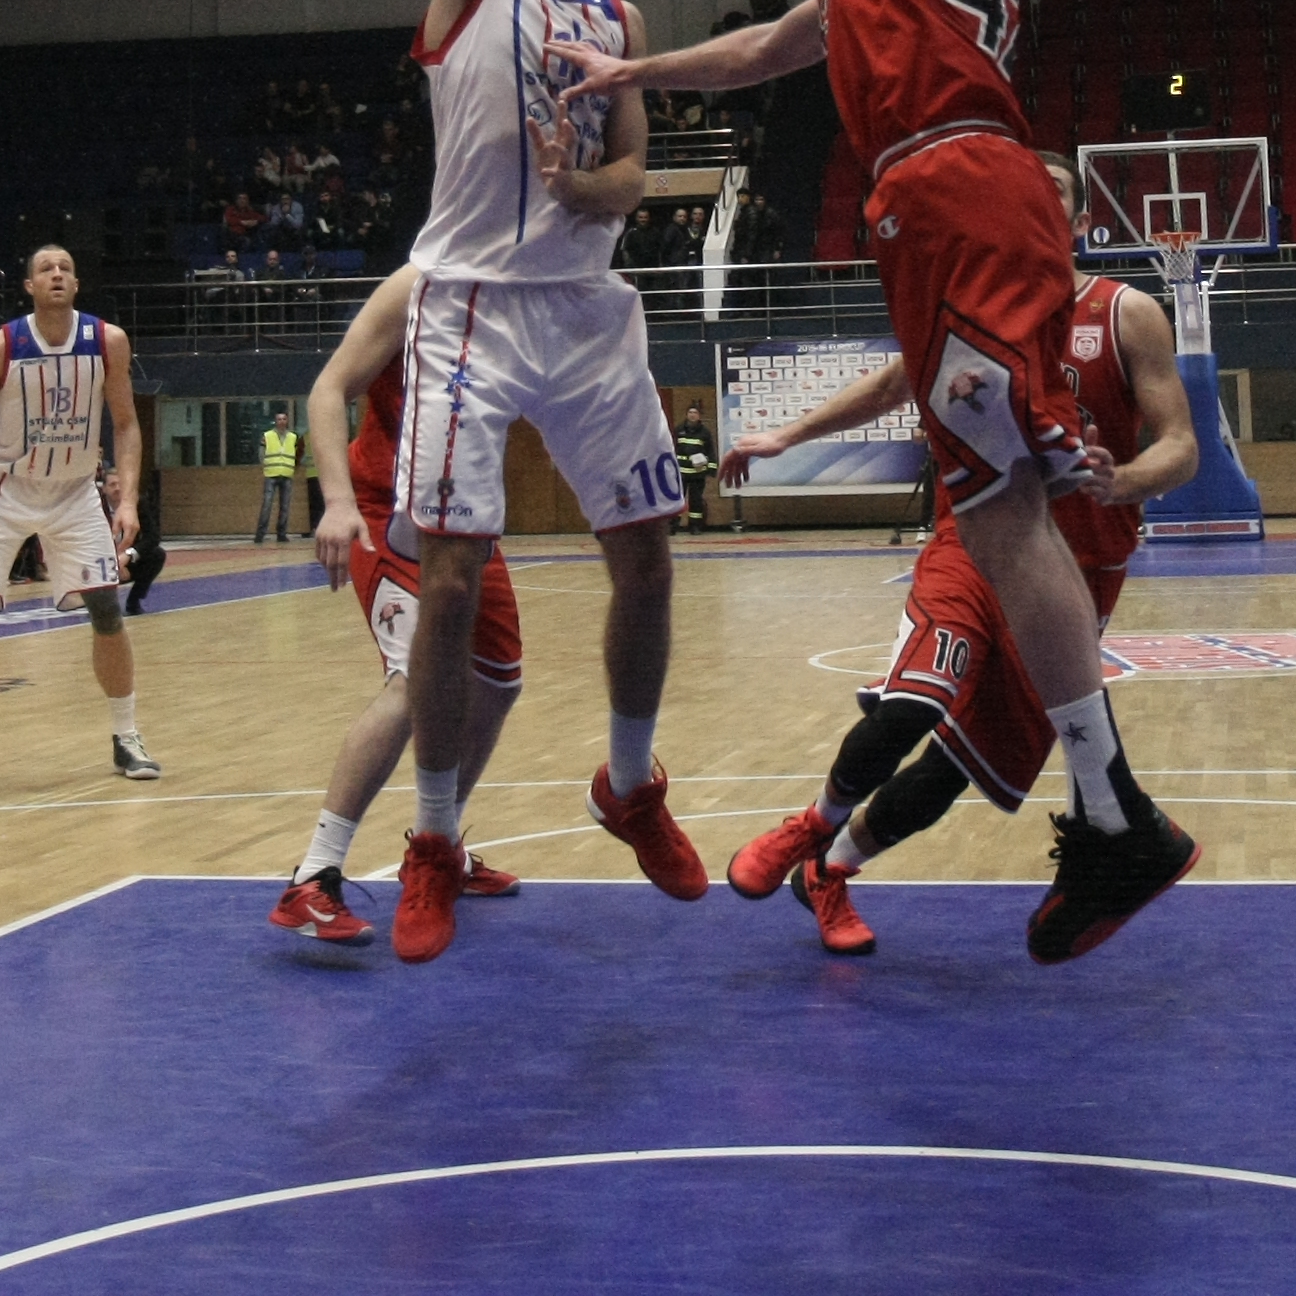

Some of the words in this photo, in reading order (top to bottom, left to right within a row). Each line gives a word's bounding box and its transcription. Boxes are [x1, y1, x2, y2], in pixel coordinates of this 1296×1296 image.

[1169, 74, 1183, 95] 2
[46, 386, 72, 413] 13
[630, 451, 682, 507] 10
[934, 628, 970, 680] 10
